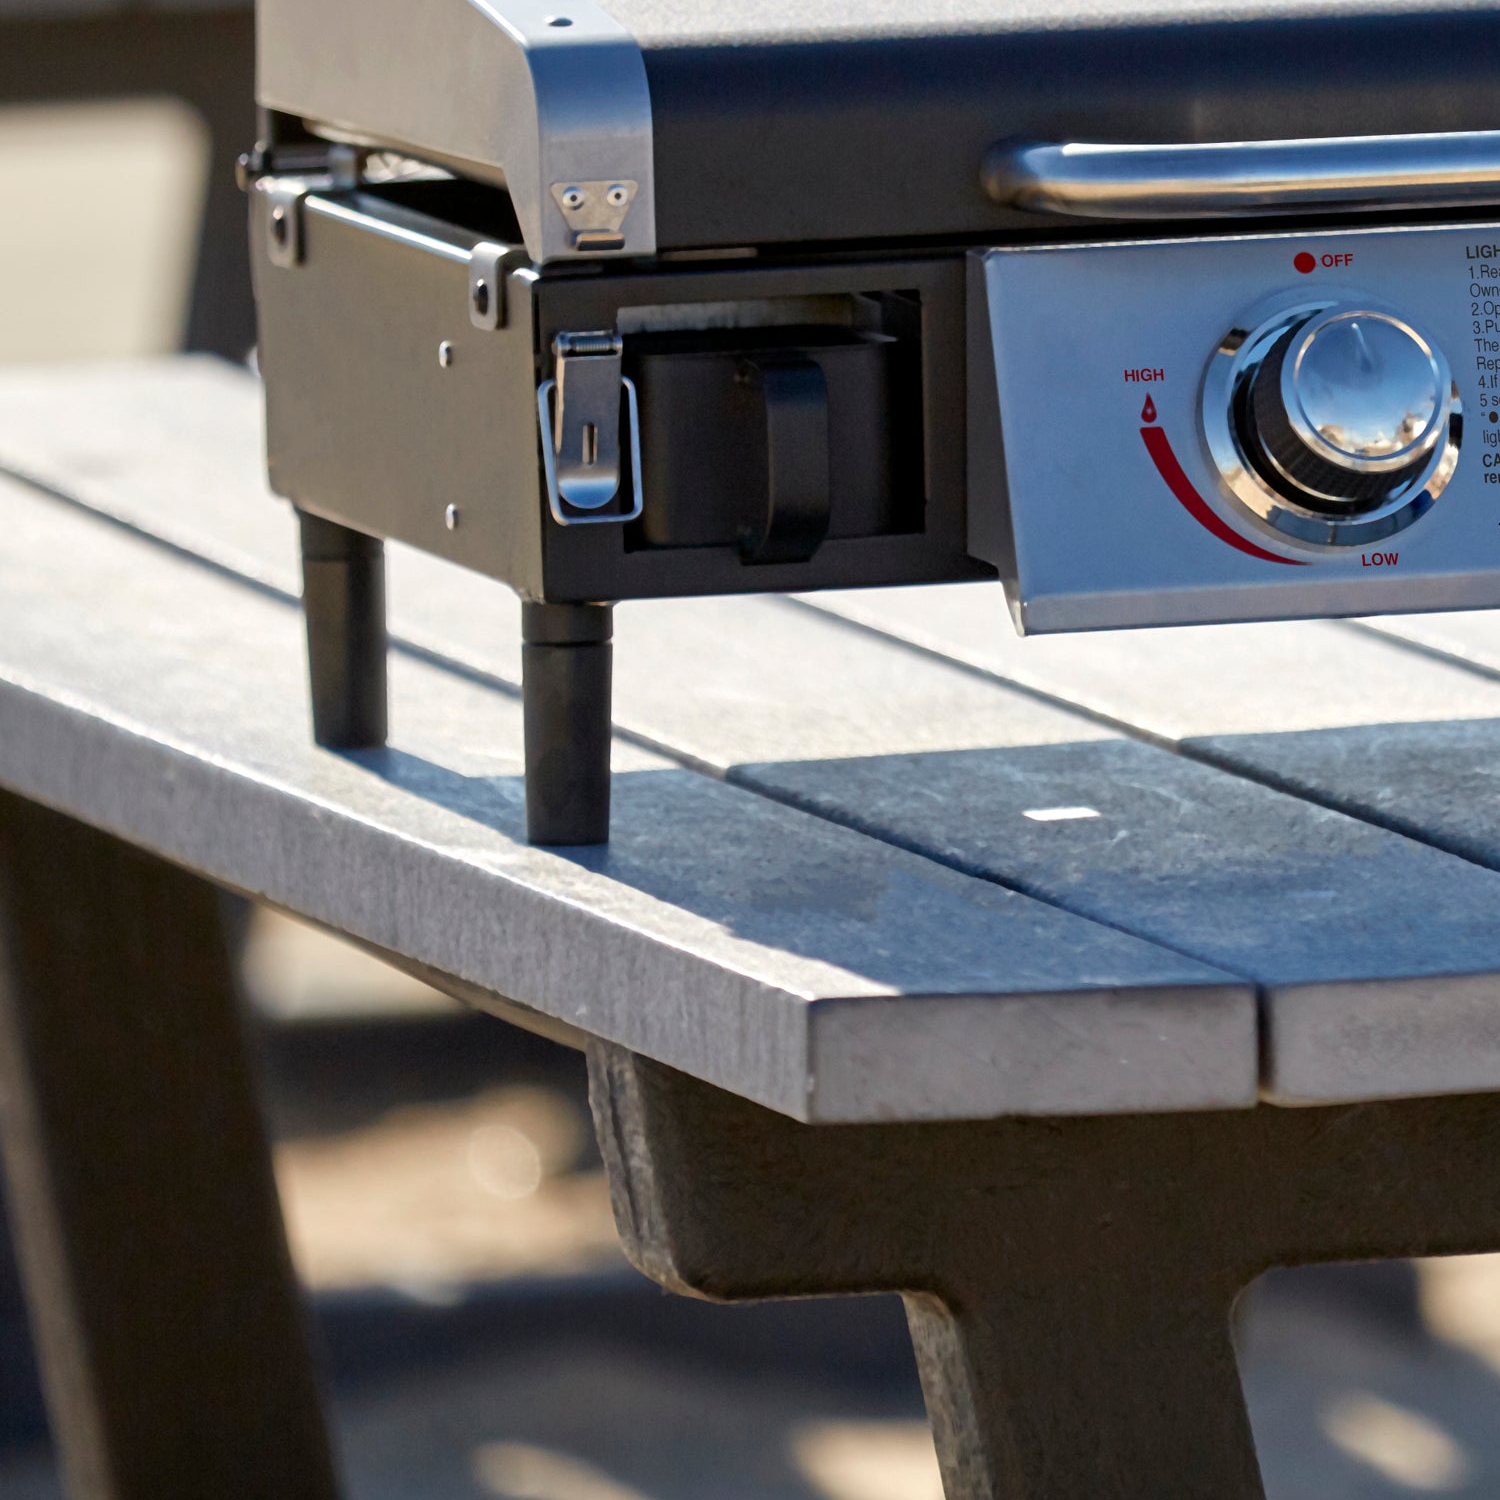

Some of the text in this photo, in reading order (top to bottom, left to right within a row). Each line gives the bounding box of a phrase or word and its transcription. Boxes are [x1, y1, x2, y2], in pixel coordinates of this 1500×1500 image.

[1321, 254, 1353, 268] OFF
[1475, 338, 1498, 352] The
[1124, 369, 1164, 382] HIGH
[1479, 374, 1497, 389] 4.If
[1480, 393, 1487, 407] 5
[1362, 553, 1398, 567] LOW
